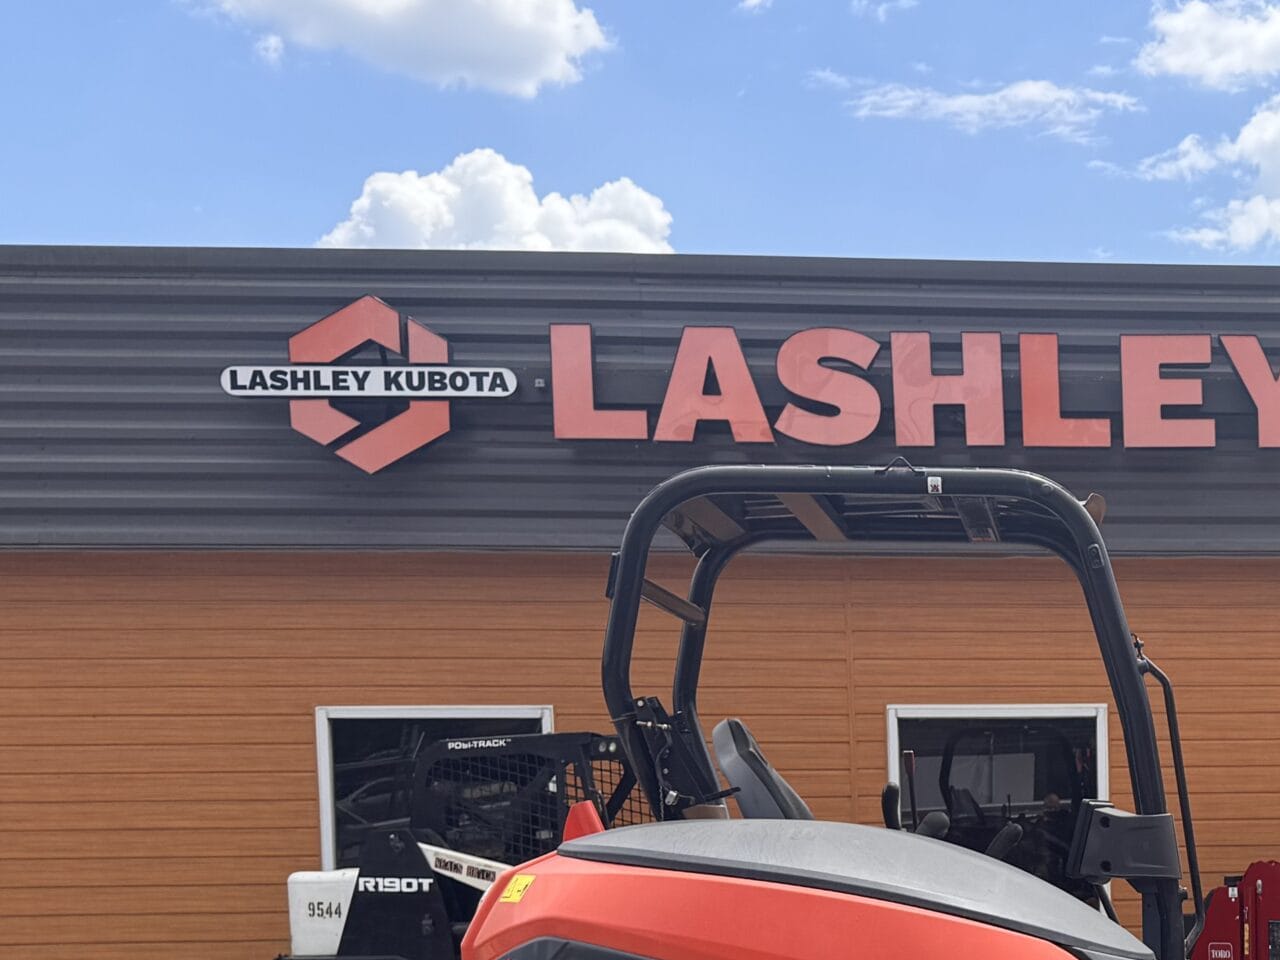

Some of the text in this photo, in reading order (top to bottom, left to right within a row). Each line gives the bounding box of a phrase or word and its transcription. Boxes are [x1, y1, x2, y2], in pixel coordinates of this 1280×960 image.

[229, 370, 509, 392] LASHLEY KUBOTA
[358, 877, 434, 892] R190T
[308, 901, 342, 918] 9544
[1211, 949, 1230, 958] TORO
